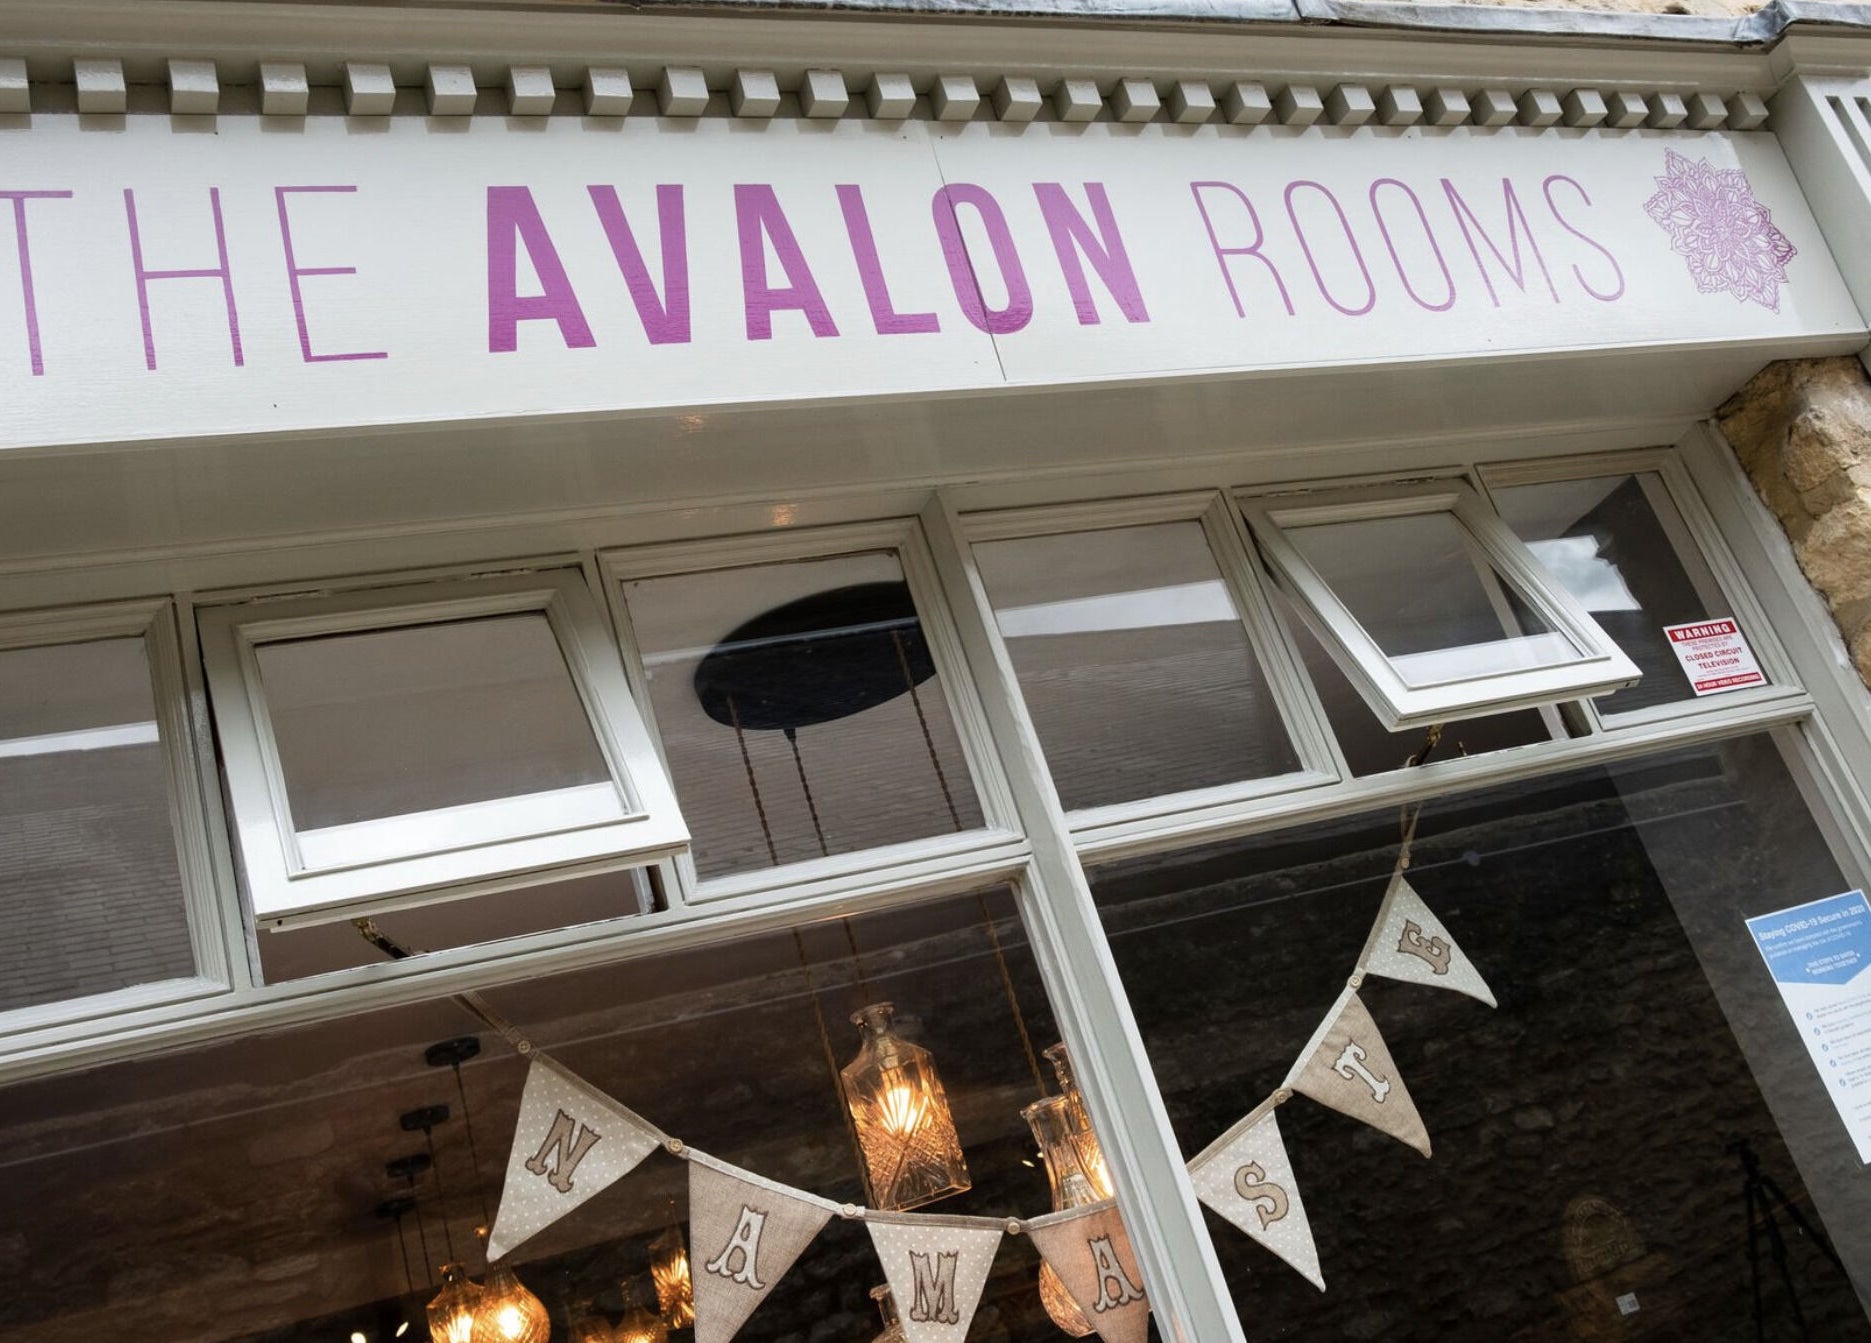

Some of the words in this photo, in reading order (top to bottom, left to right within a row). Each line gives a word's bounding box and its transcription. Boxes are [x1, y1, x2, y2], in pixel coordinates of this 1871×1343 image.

[0, 184, 389, 376] THE
[487, 181, 1151, 354] AVALON
[1190, 174, 1626, 318] ROOMS
[1674, 624, 1731, 640] WARNING
[1685, 652, 1713, 661] CLOSED
[1714, 647, 1742, 657] CIRCUIT
[1698, 658, 1739, 669] TELEVISION
[1784, 917, 1818, 934] COVID-19
[1817, 912, 1842, 925] Secure
